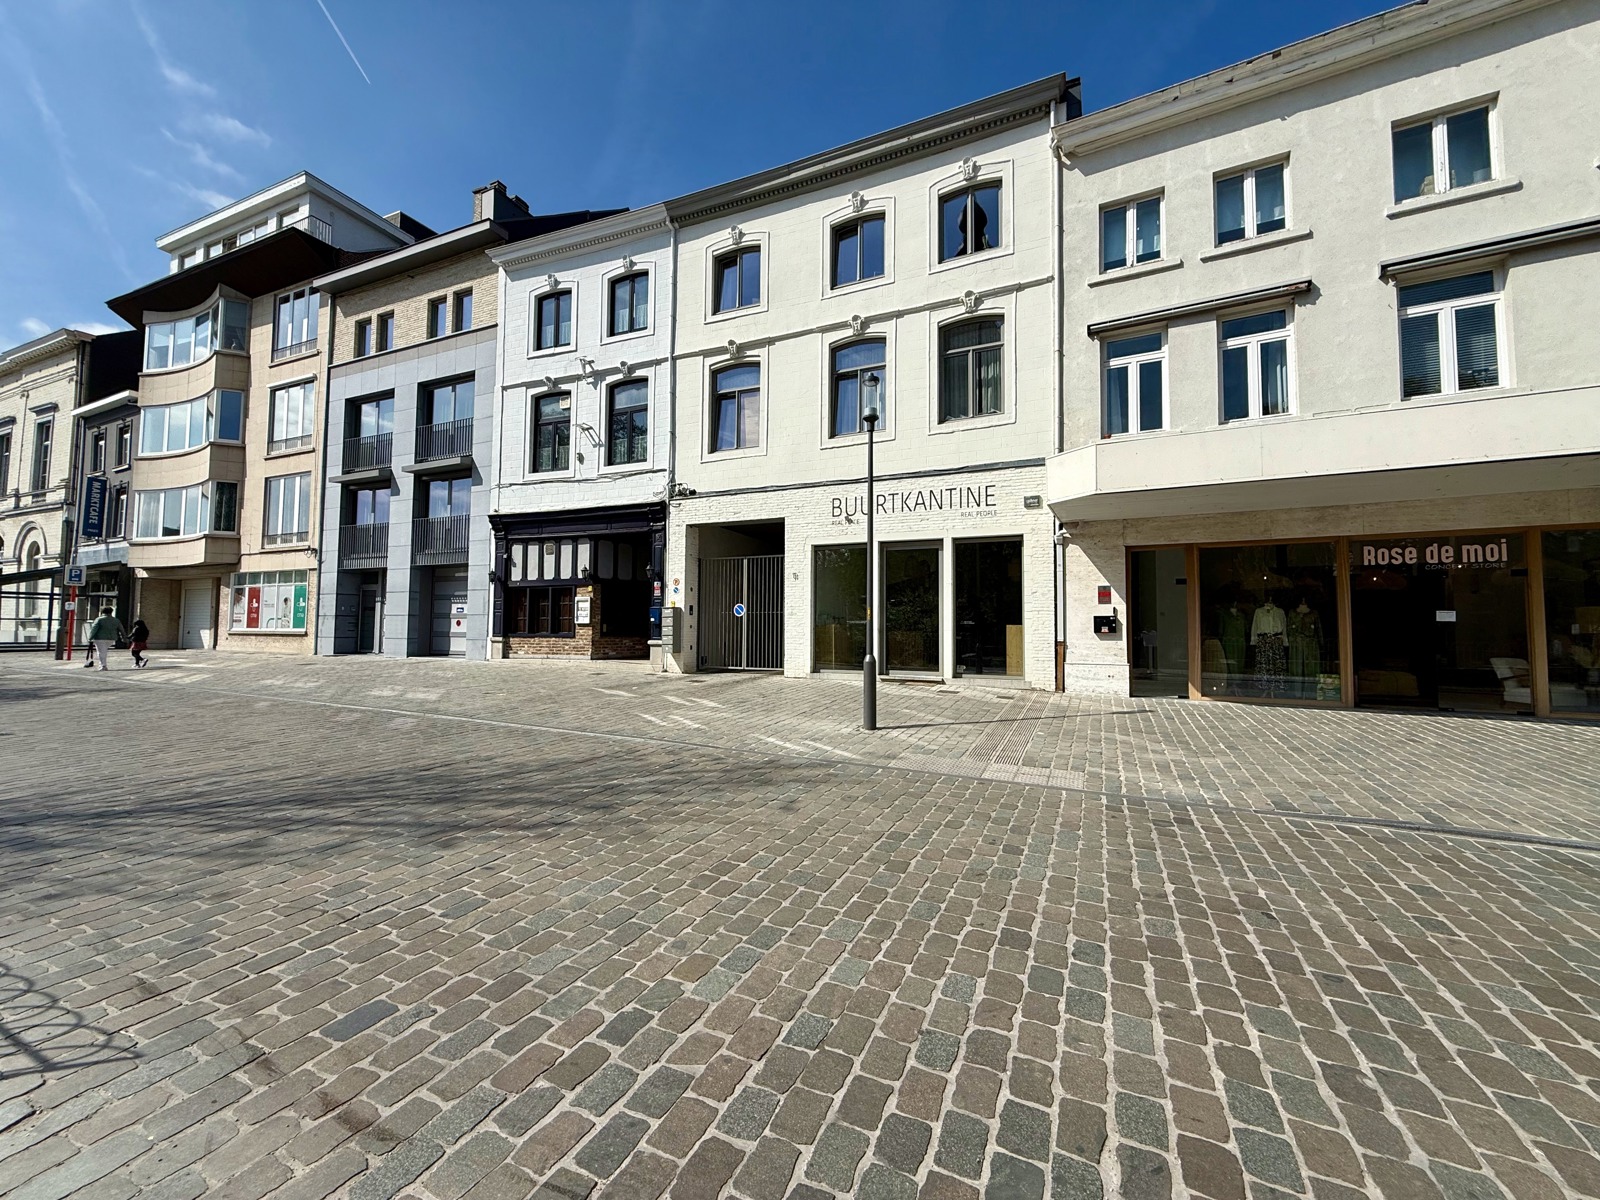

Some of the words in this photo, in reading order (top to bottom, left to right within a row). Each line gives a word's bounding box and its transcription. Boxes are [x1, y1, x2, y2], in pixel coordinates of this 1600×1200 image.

[89, 481, 101, 525] MARKTCAFE
[831, 485, 997, 518] BUURTKANTINE
[1363, 545, 1418, 566] Rose
[1425, 543, 1454, 563] de
[1461, 538, 1508, 563] moi
